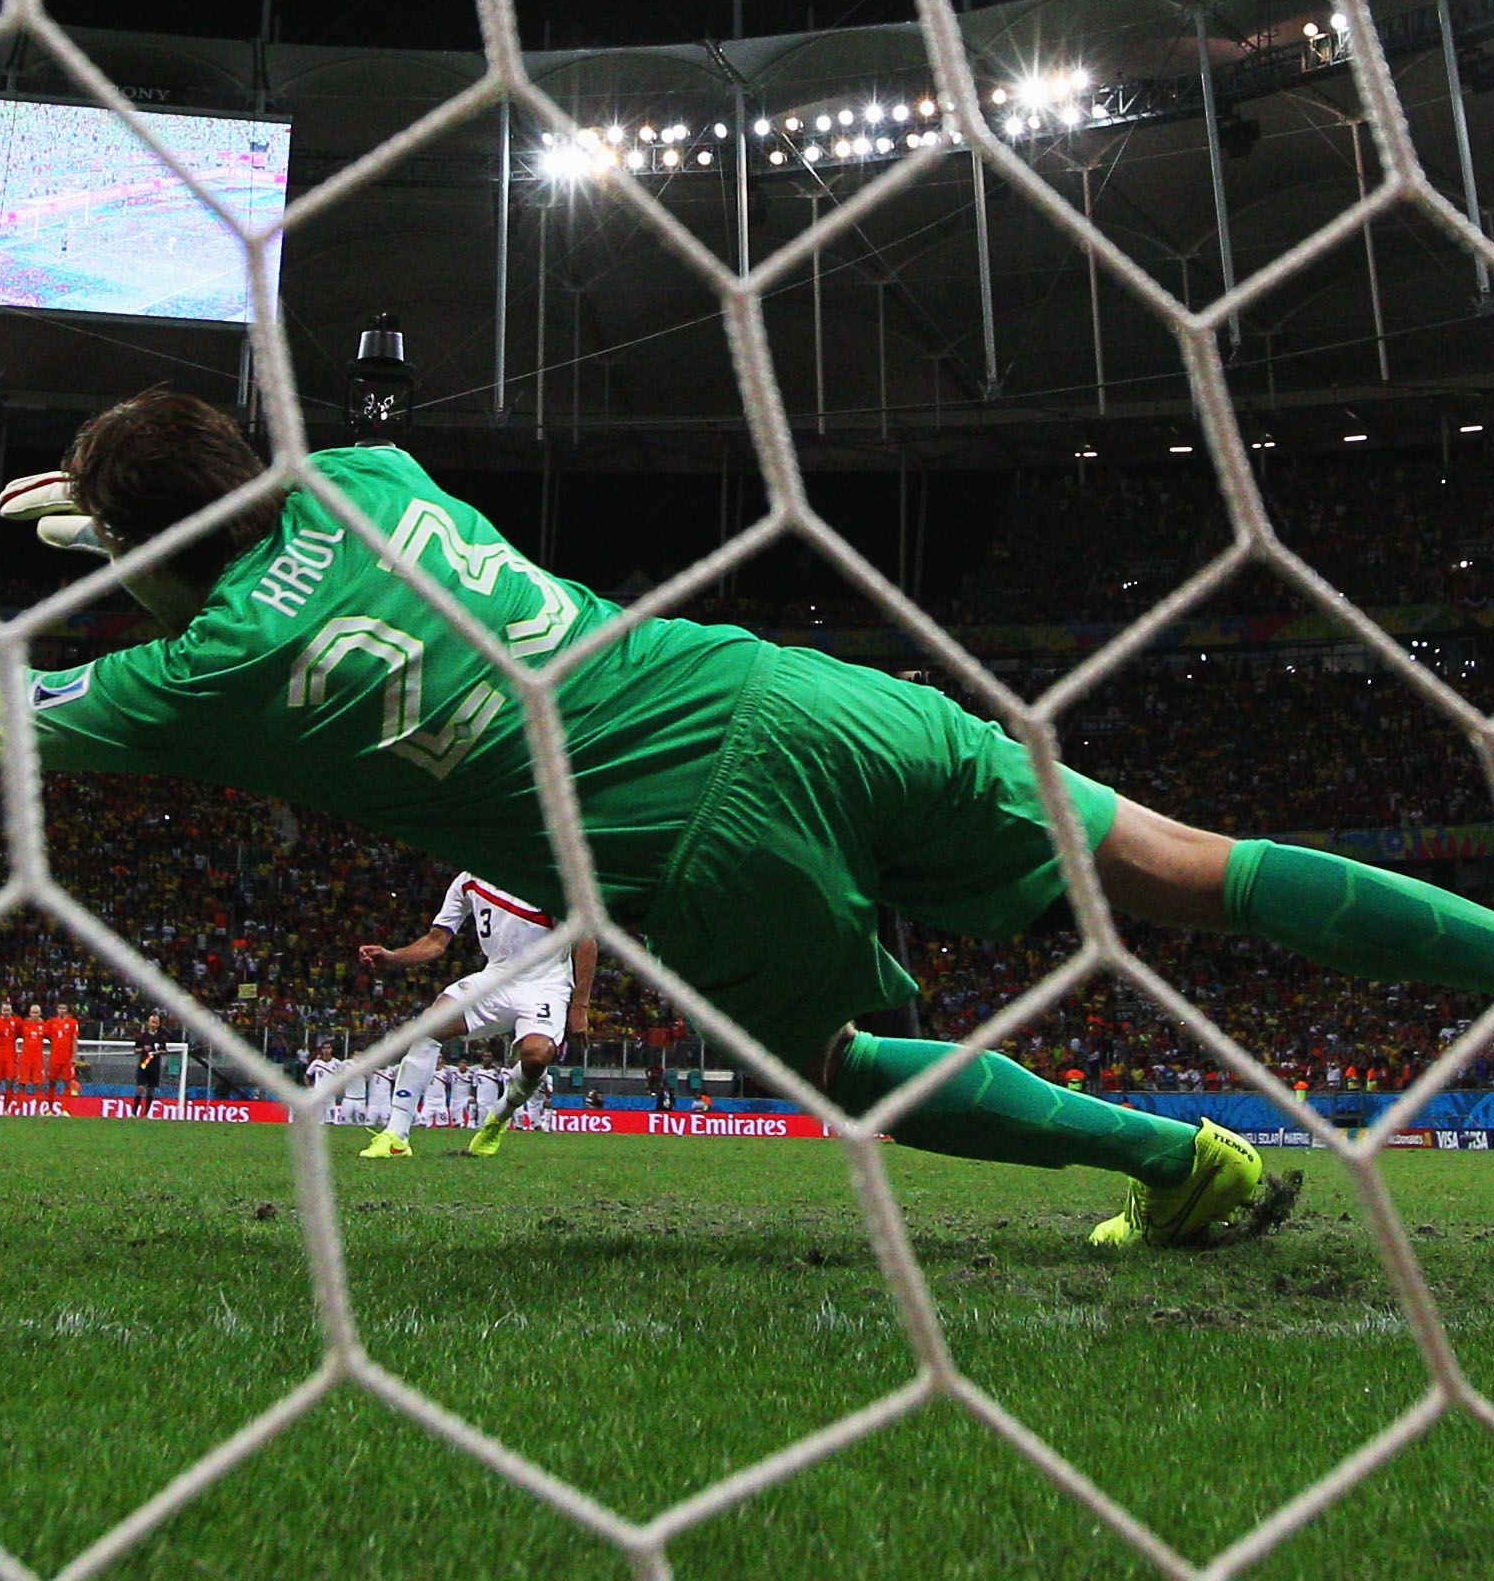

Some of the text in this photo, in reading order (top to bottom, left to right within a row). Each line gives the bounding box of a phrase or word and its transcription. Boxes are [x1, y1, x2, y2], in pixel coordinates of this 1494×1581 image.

[120, 85, 170, 101] ONY
[251, 528, 346, 618] KRUL
[287, 498, 579, 781] 23
[479, 908, 492, 938] 3
[536, 1003, 551, 1018] 3
[552, 1111, 612, 1133] irates
[648, 1113, 787, 1137] Fly Emirates
[1213, 1132, 1255, 1163] TIEMPO
[1435, 1130, 1460, 1150] VISA
